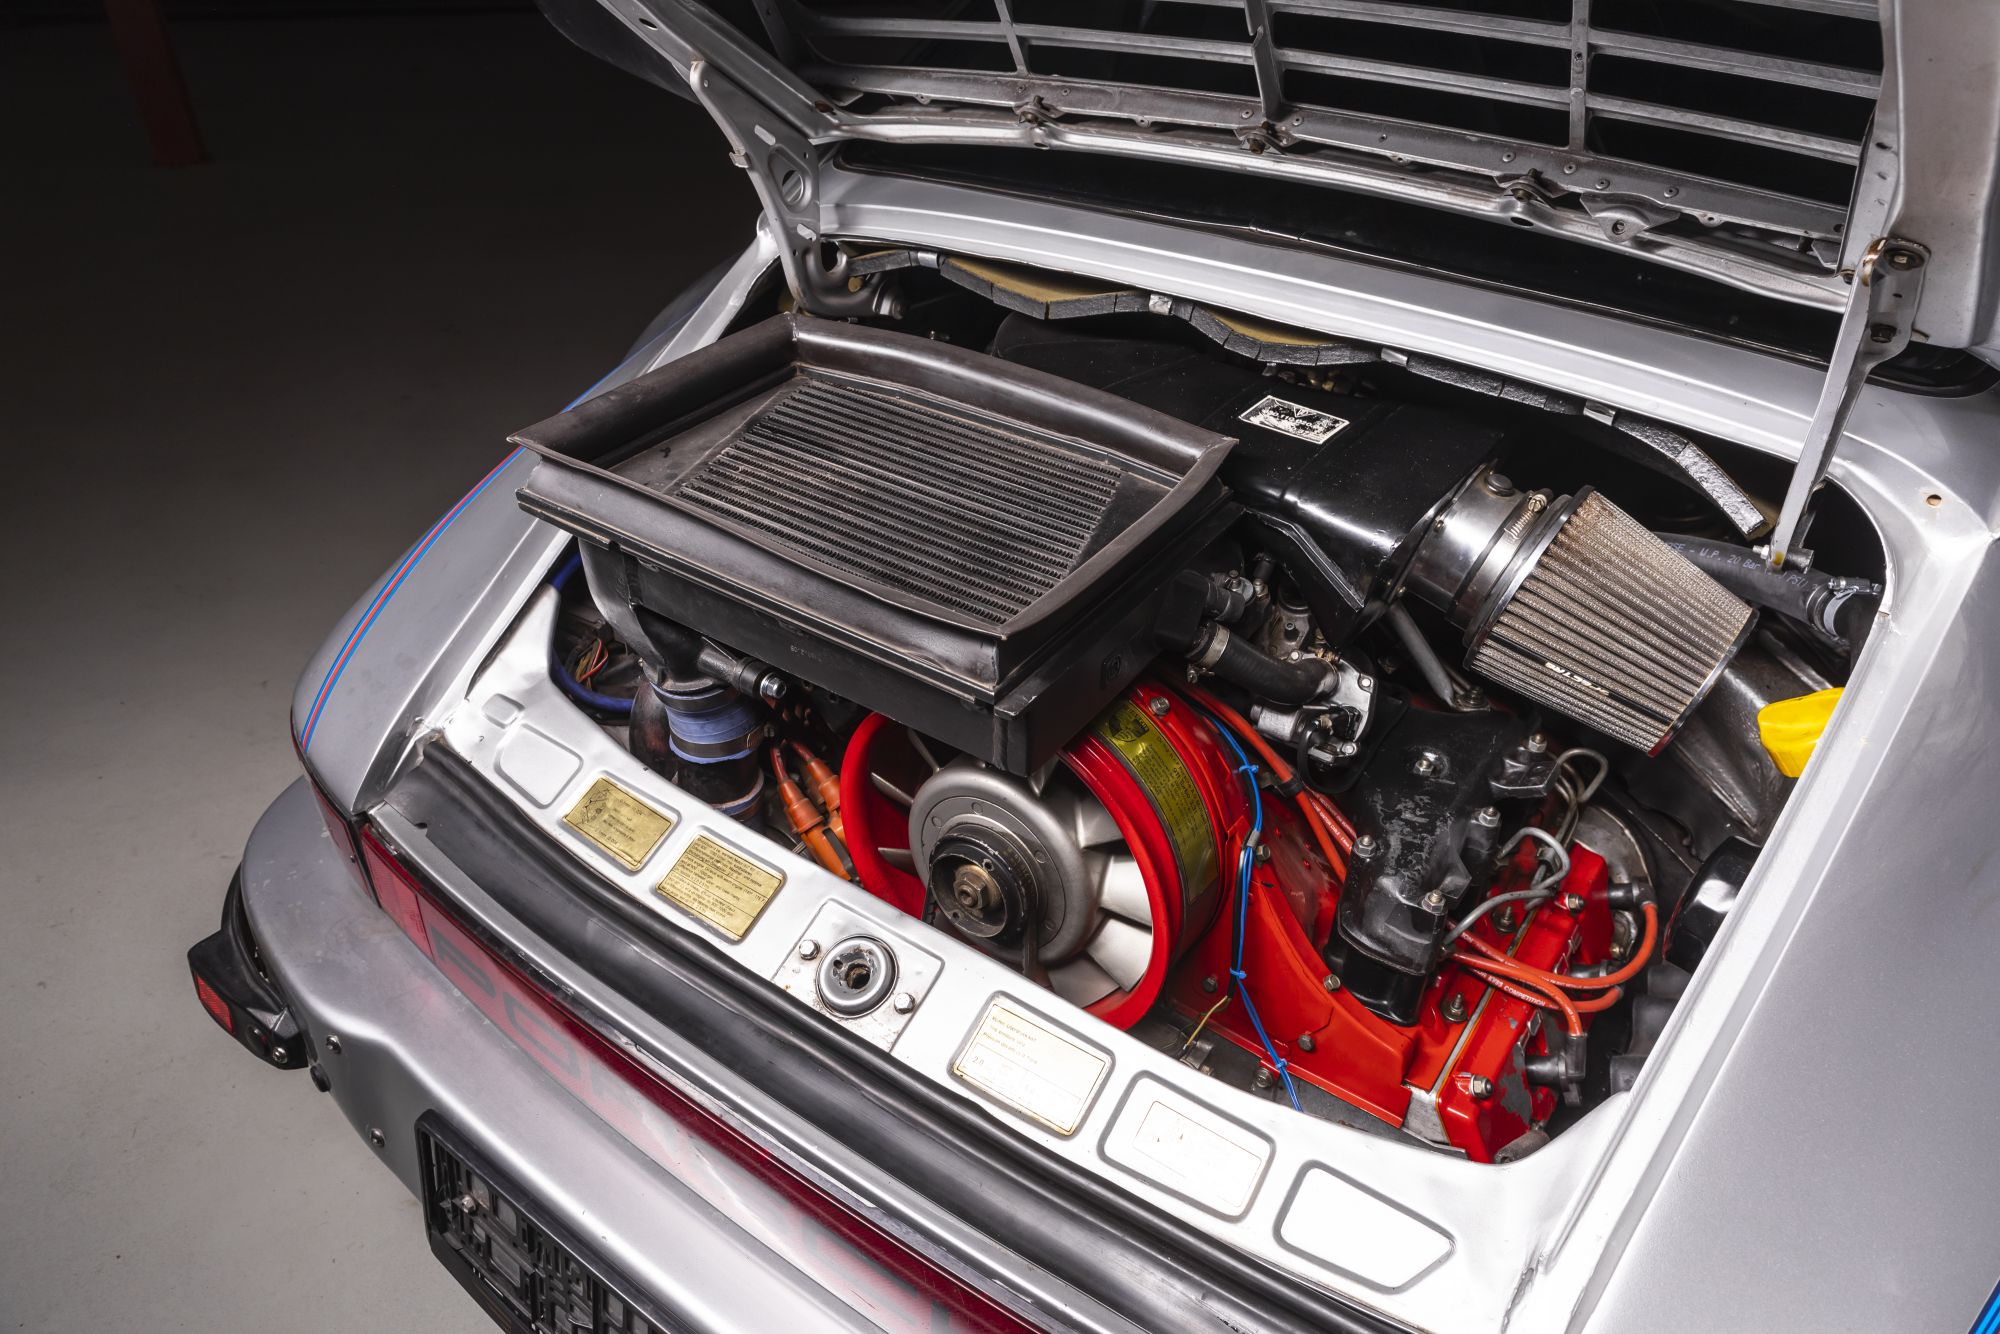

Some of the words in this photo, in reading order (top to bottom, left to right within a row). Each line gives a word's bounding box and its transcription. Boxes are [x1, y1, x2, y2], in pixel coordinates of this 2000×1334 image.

[1727, 555, 1740, 565] 20
[1743, 558, 1761, 569] Bar
[1503, 985, 1546, 1007] COMPETITION
